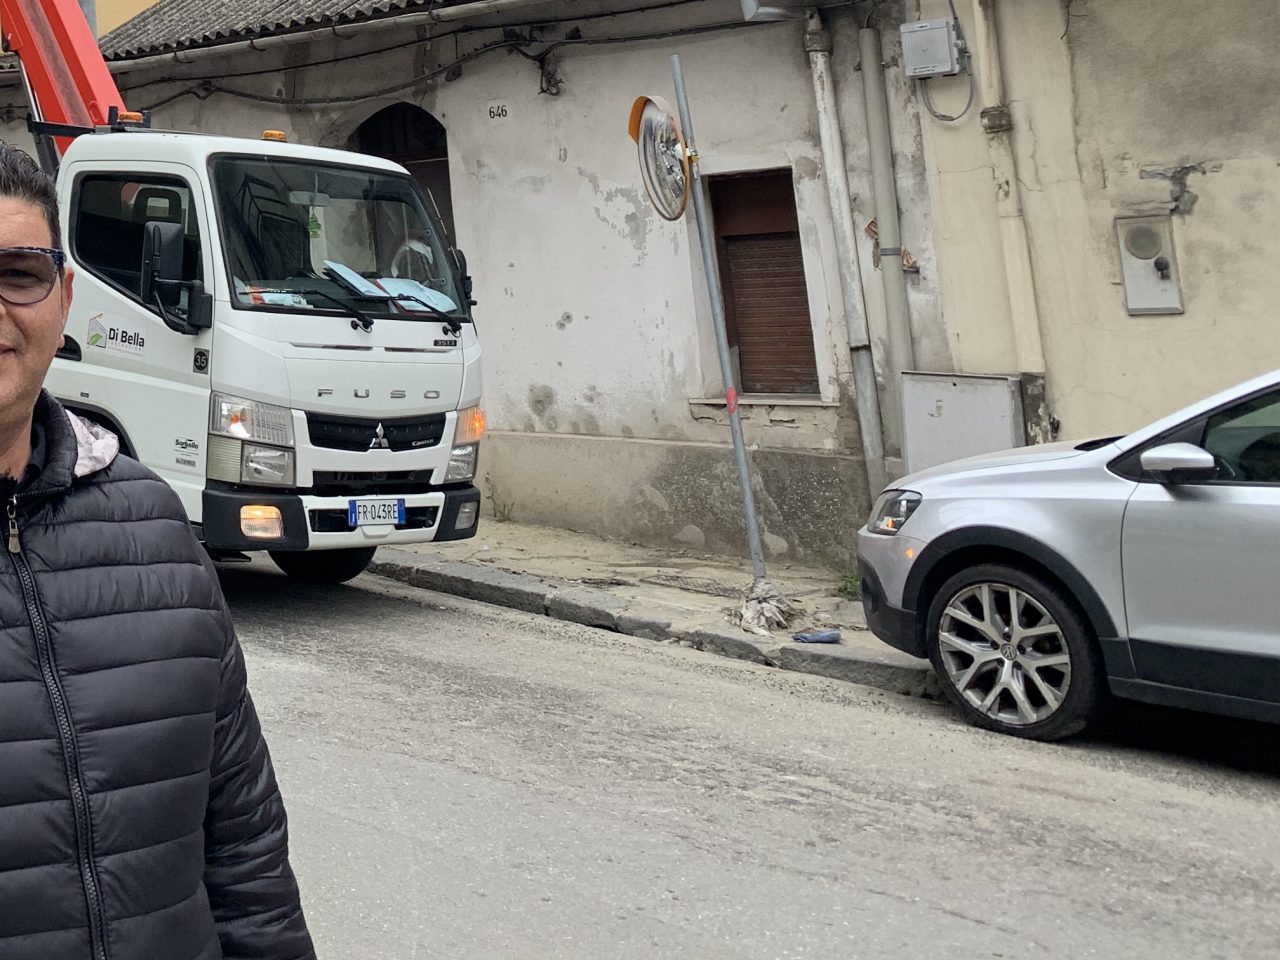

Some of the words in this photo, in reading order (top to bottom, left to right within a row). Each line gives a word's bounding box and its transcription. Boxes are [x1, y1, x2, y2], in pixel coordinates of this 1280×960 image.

[489, 104, 508, 119] 646
[108, 327, 119, 341] Di
[120, 330, 145, 347] Bella
[195, 354, 207, 367] 35
[317, 388, 441, 399] FUSO
